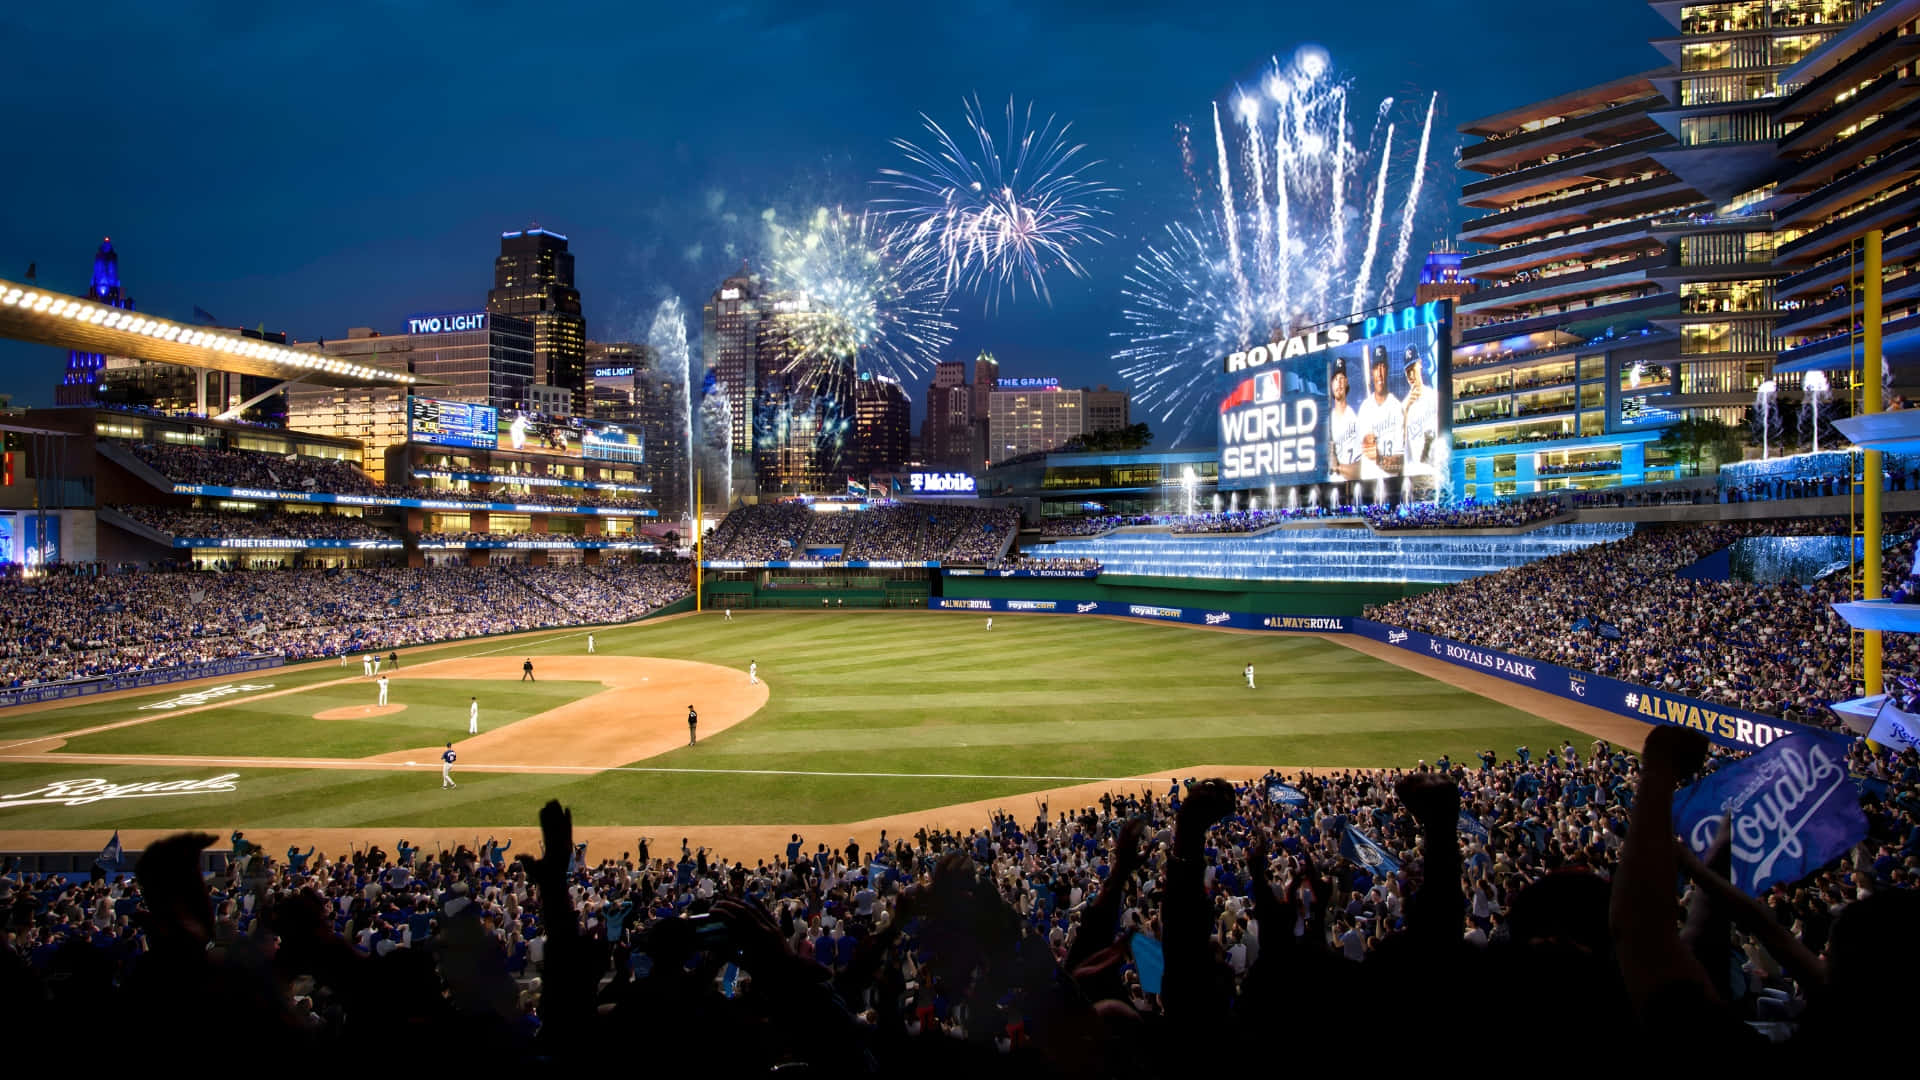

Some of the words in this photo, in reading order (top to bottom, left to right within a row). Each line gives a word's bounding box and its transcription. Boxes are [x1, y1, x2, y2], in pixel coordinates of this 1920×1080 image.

[409, 318, 441, 333] TWO
[444, 314, 484, 331] LIGHT
[1228, 325, 1349, 373] ROYALS
[1365, 299, 1437, 339] PARK
[612, 367, 633, 376] LIGHT
[997, 378, 1018, 386] THE
[1021, 377, 1058, 385] GRAND
[1221, 399, 1318, 445] WORLD
[1223, 436, 1317, 479] SERIES
[231, 489, 277, 498] ROYALS
[941, 600, 992, 609] #ALWAYSROYAL
[1008, 601, 1056, 610] royals.com
[1130, 605, 1182, 617] royals.com
[1263, 617, 1343, 630] #ALWAYSROYAL
[1388, 630, 1409, 644] Royals
[1447, 645, 1493, 667] ROYALS
[1496, 657, 1536, 680] PARK
[1570, 681, 1585, 697] KC
